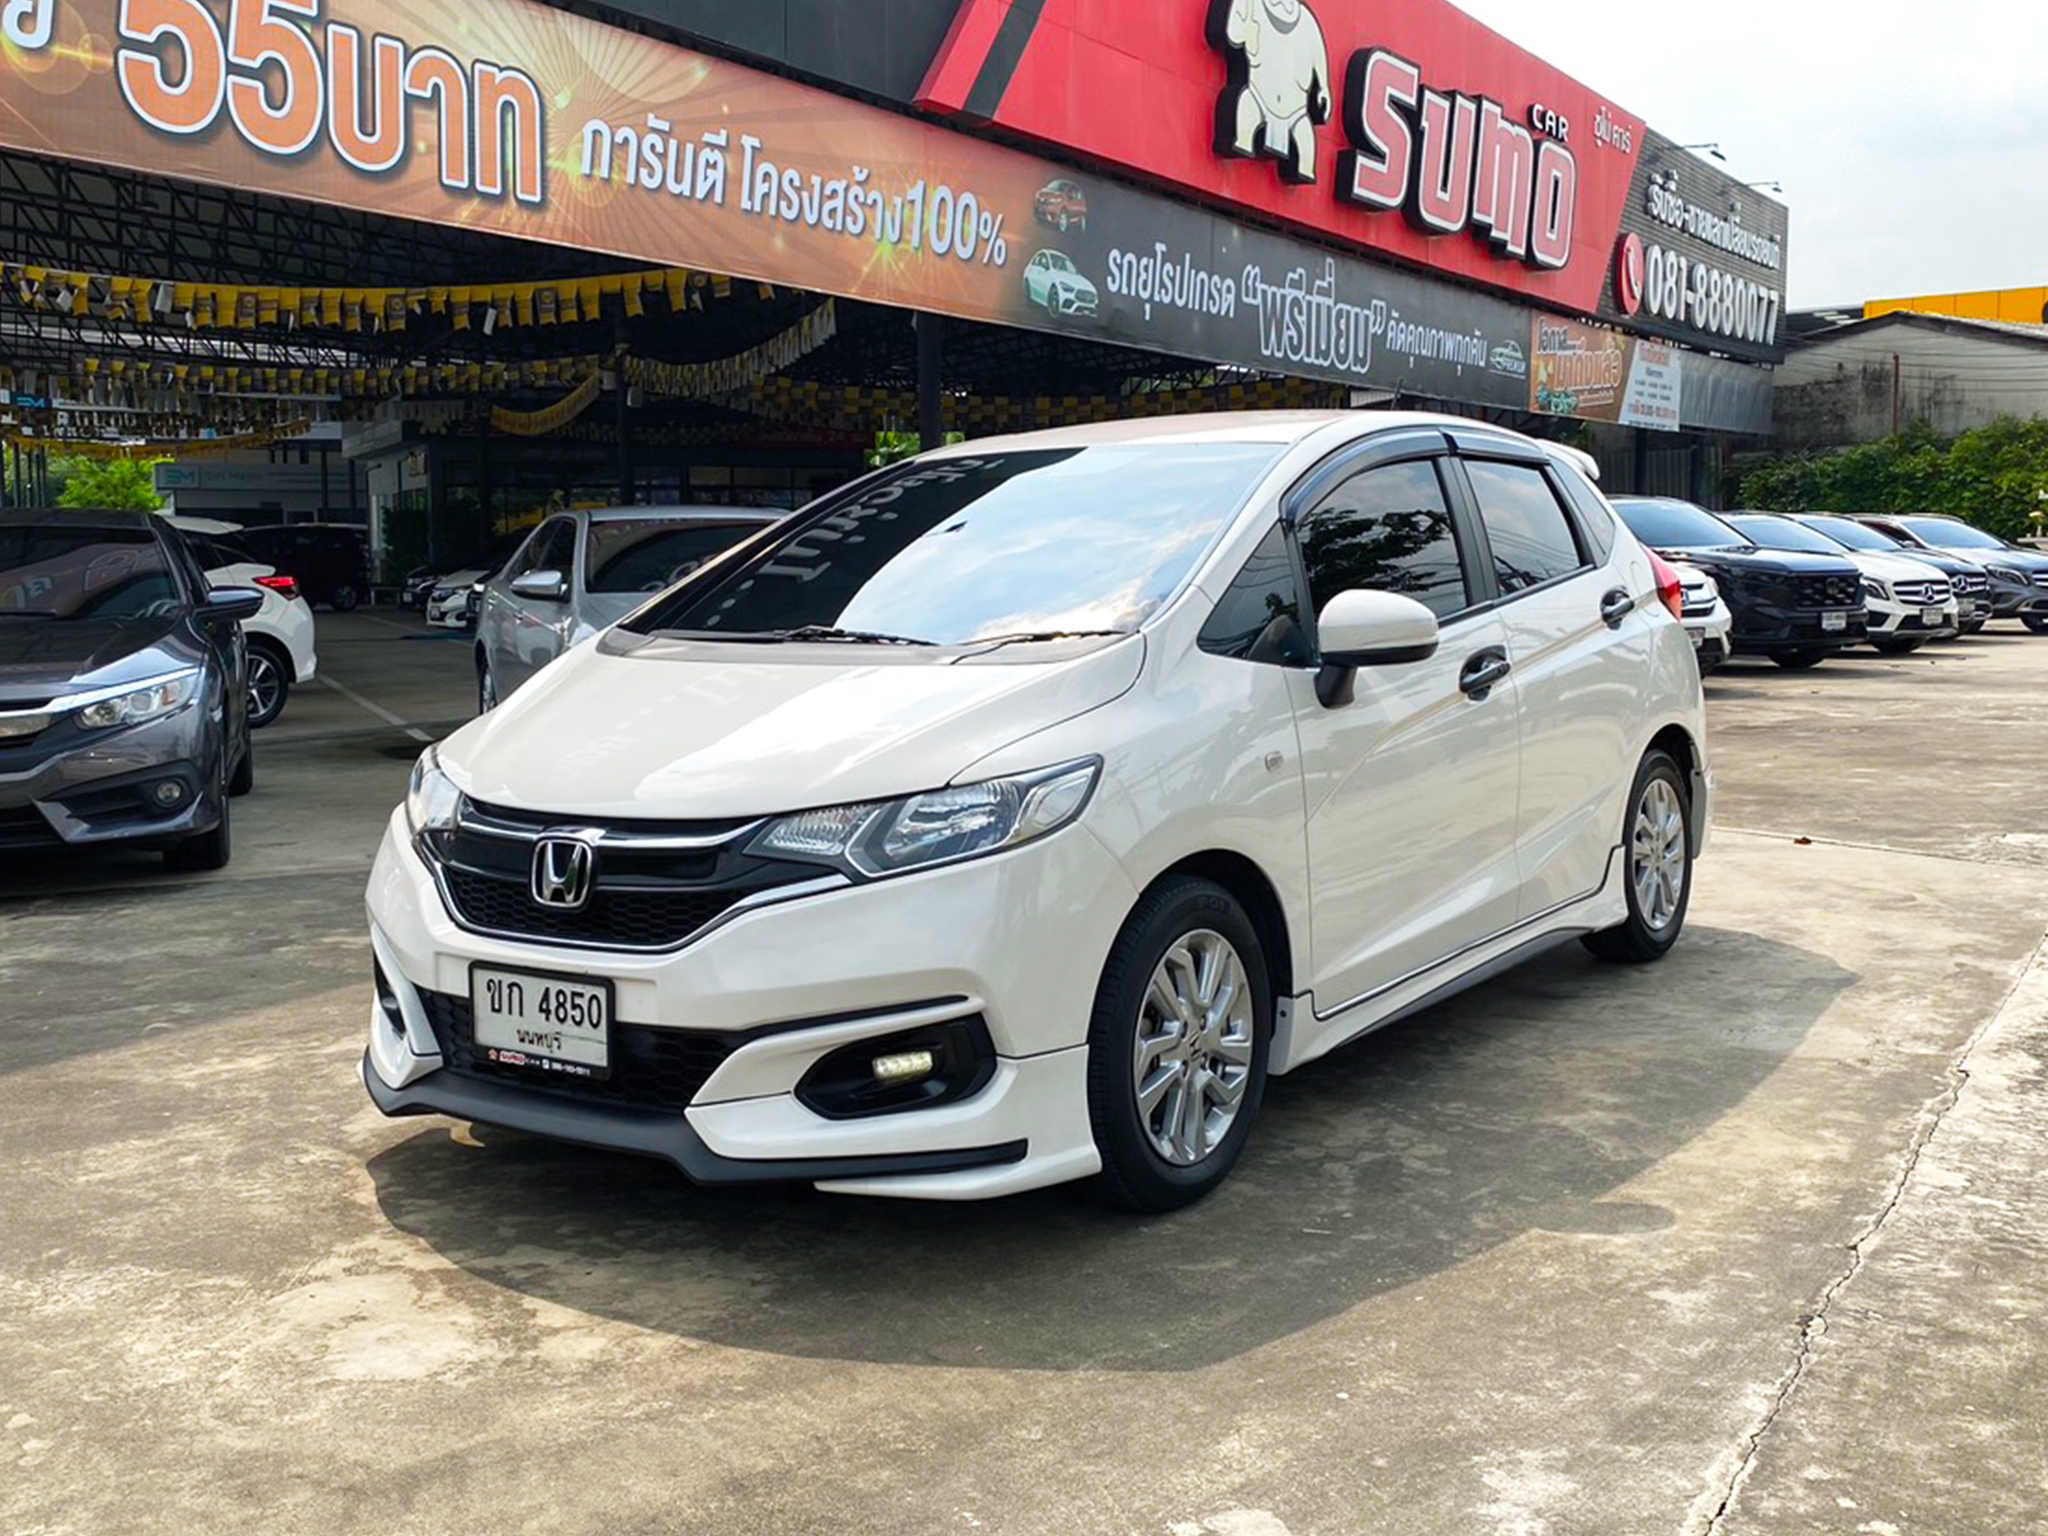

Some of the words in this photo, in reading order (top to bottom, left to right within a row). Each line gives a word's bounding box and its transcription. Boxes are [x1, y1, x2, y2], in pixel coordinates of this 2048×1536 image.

[1533, 103, 1569, 142] CAR
[580, 113, 728, 205] การันตี
[1645, 244, 1779, 346] 081-8880077
[486, 977, 524, 1018] ขก
[538, 986, 602, 1029] 4850
[516, 1028, 563, 1054] นนทบุรี
